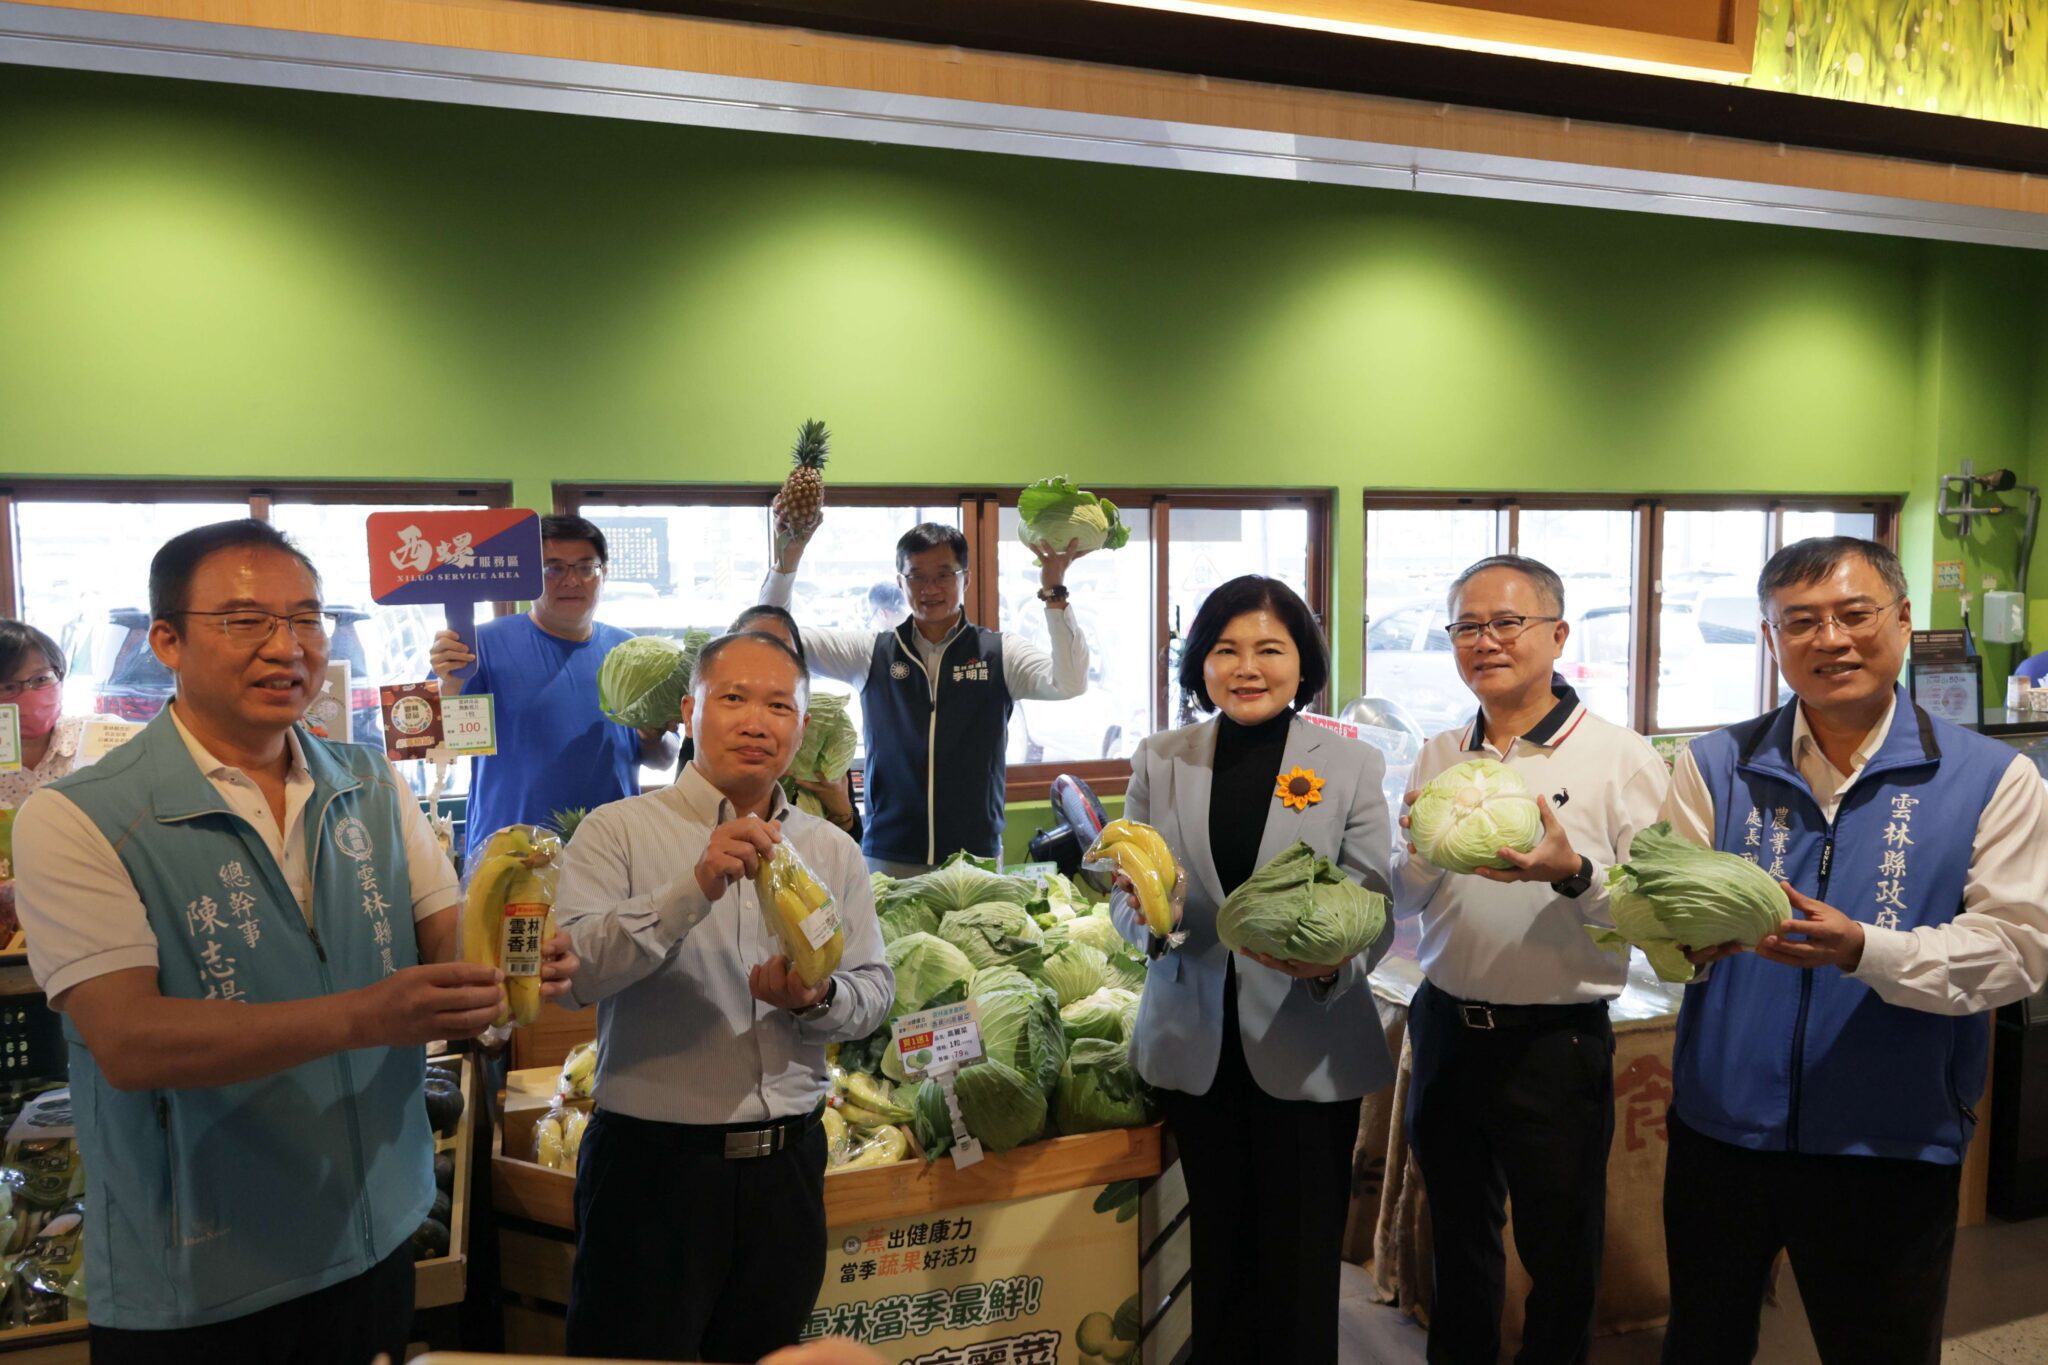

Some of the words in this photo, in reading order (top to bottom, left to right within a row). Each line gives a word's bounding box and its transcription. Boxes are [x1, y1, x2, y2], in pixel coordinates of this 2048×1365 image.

[479, 556, 519, 568] 服務區
[397, 573, 433, 582] XILUO
[437, 572, 487, 581] SERVICE
[490, 571, 520, 580] AREA
[953, 669, 988, 681] 李明哲
[459, 722, 481, 733] 100
[1768, 806, 1790, 881] 農業處
[1820, 845, 1831, 876] YUNLIN
[1875, 793, 1920, 931] 雲林縣政府
[219, 860, 261, 949] 總幹事
[509, 918, 540, 935] 雲林
[507, 936, 539, 953] 香蕉
[864, 1216, 972, 1254] 蕉出健康力
[840, 1244, 977, 1285] 當季蔬果好活力
